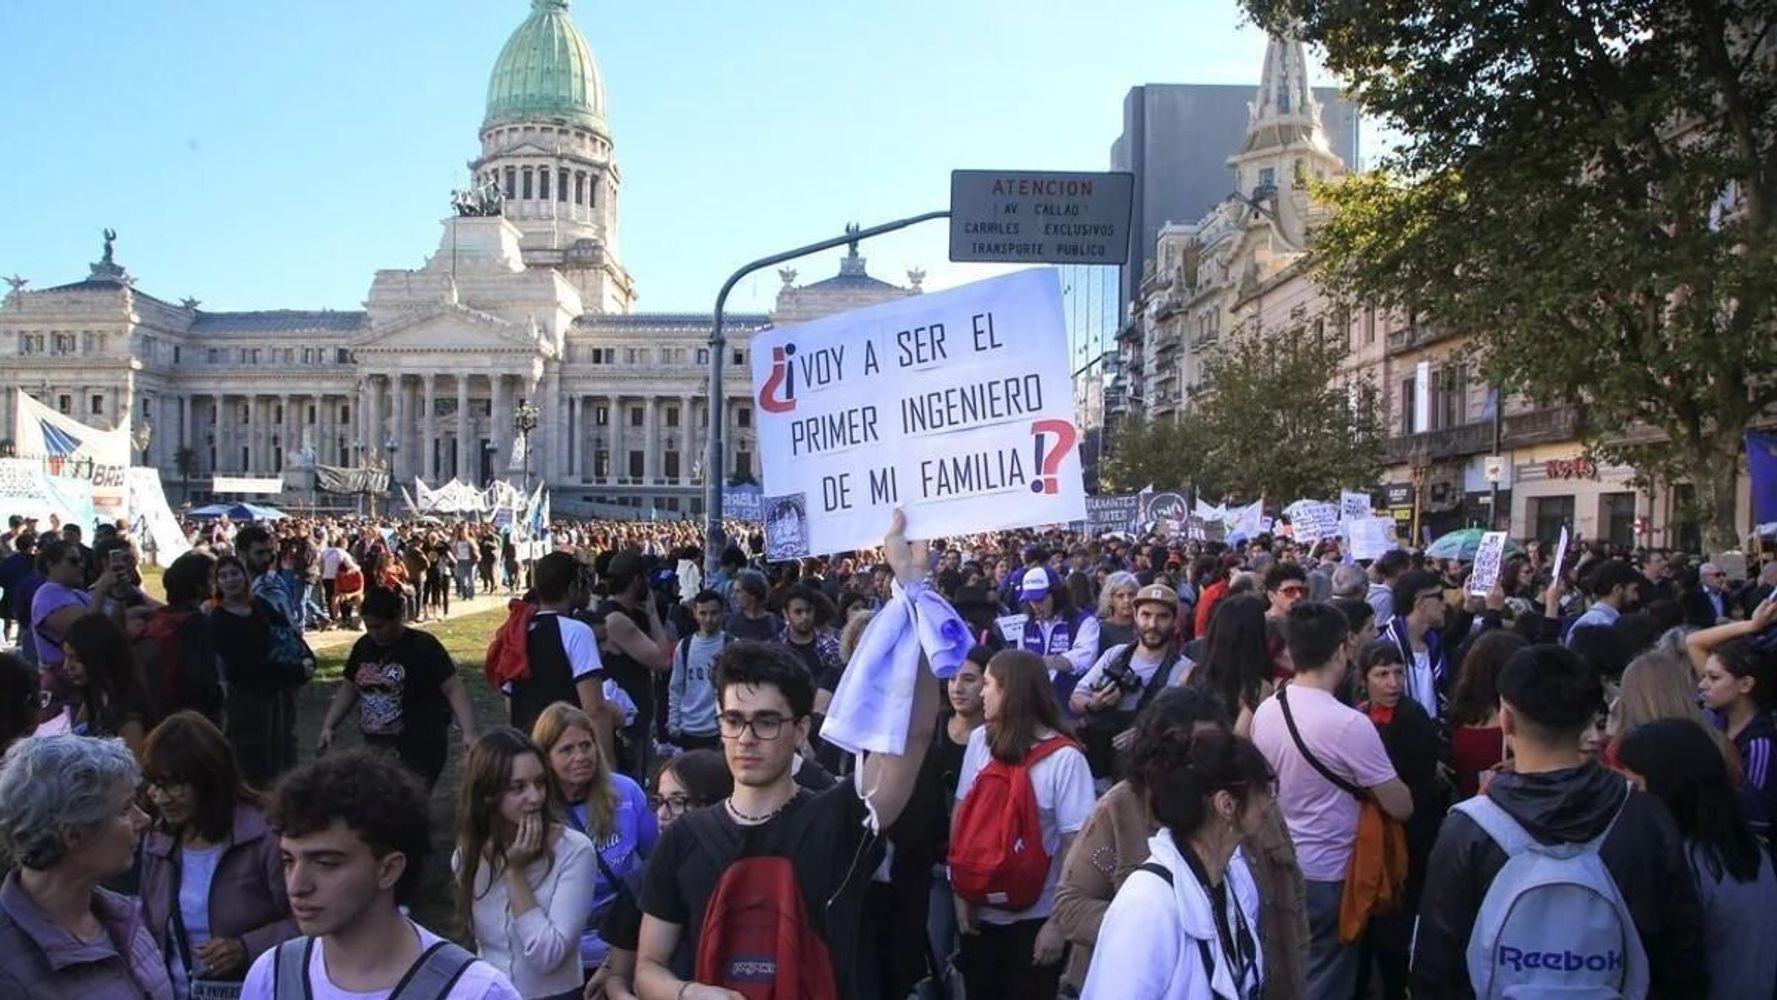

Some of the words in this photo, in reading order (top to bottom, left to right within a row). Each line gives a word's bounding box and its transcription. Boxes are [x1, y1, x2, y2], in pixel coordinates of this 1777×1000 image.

[992, 178, 1093, 197] ATENCION
[1004, 203, 1018, 214] AV
[1034, 203, 1080, 217] CALLAO
[964, 222, 1020, 235] CARRILES
[1044, 223, 1115, 237] EXCLUSIVOS
[971, 242, 1044, 255] TRANSPORTE
[1056, 243, 1106, 257] PUBLICO
[864, 340, 880, 375] A
[896, 324, 948, 367] SER
[972, 312, 1003, 352] EL
[791, 406, 878, 456] PRIMER
[902, 374, 1042, 434] INGENIERO
[823, 473, 853, 513] DE
[870, 466, 899, 506] MI
[1499, 946, 1622, 972] Reebok
